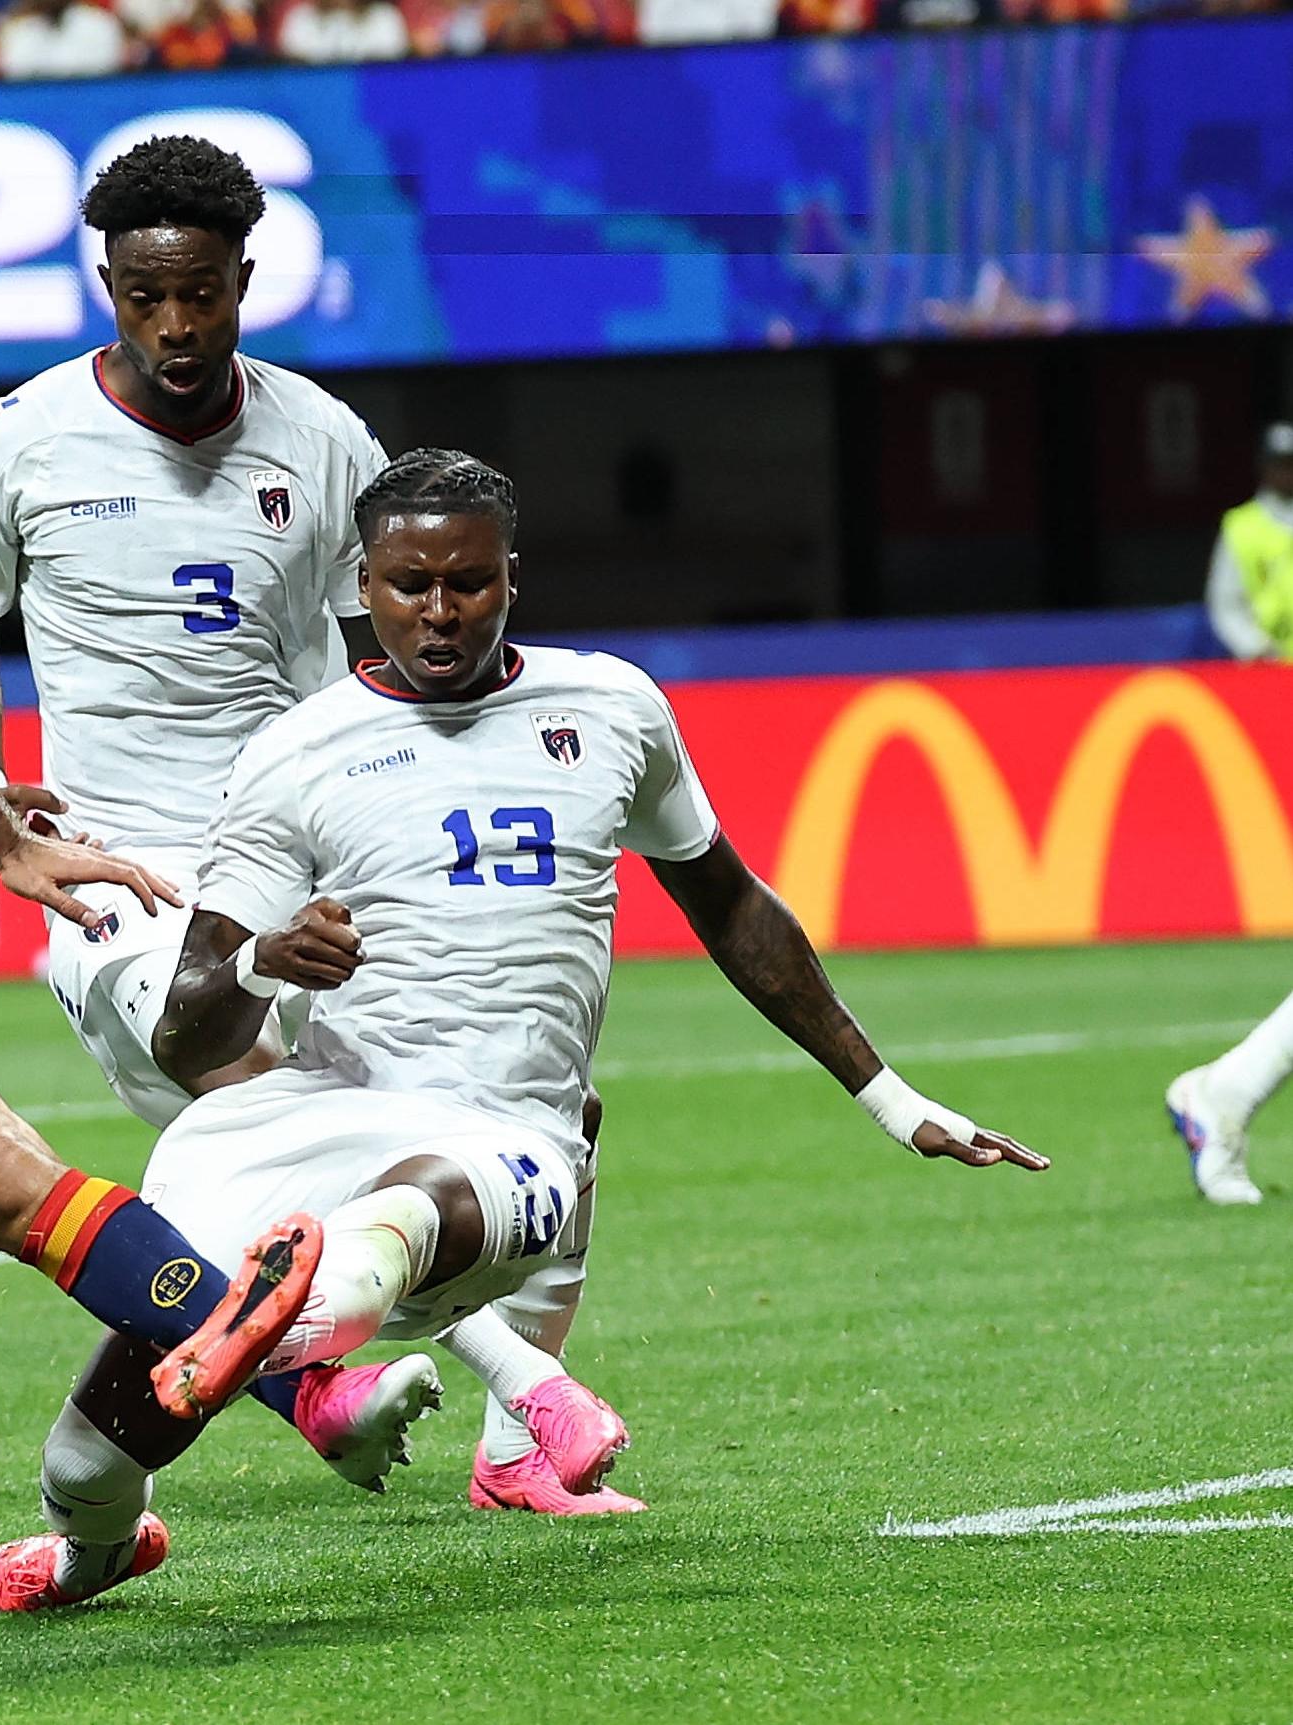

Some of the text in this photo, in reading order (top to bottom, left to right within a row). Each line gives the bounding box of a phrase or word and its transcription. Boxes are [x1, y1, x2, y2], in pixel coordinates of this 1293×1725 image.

[253, 472, 286, 483] FCF
[70, 496, 137, 518] capelli
[172, 563, 241, 635] 3
[536, 714, 572, 724] FCF
[347, 747, 416, 777] capelli
[441, 806, 556, 887] 13
